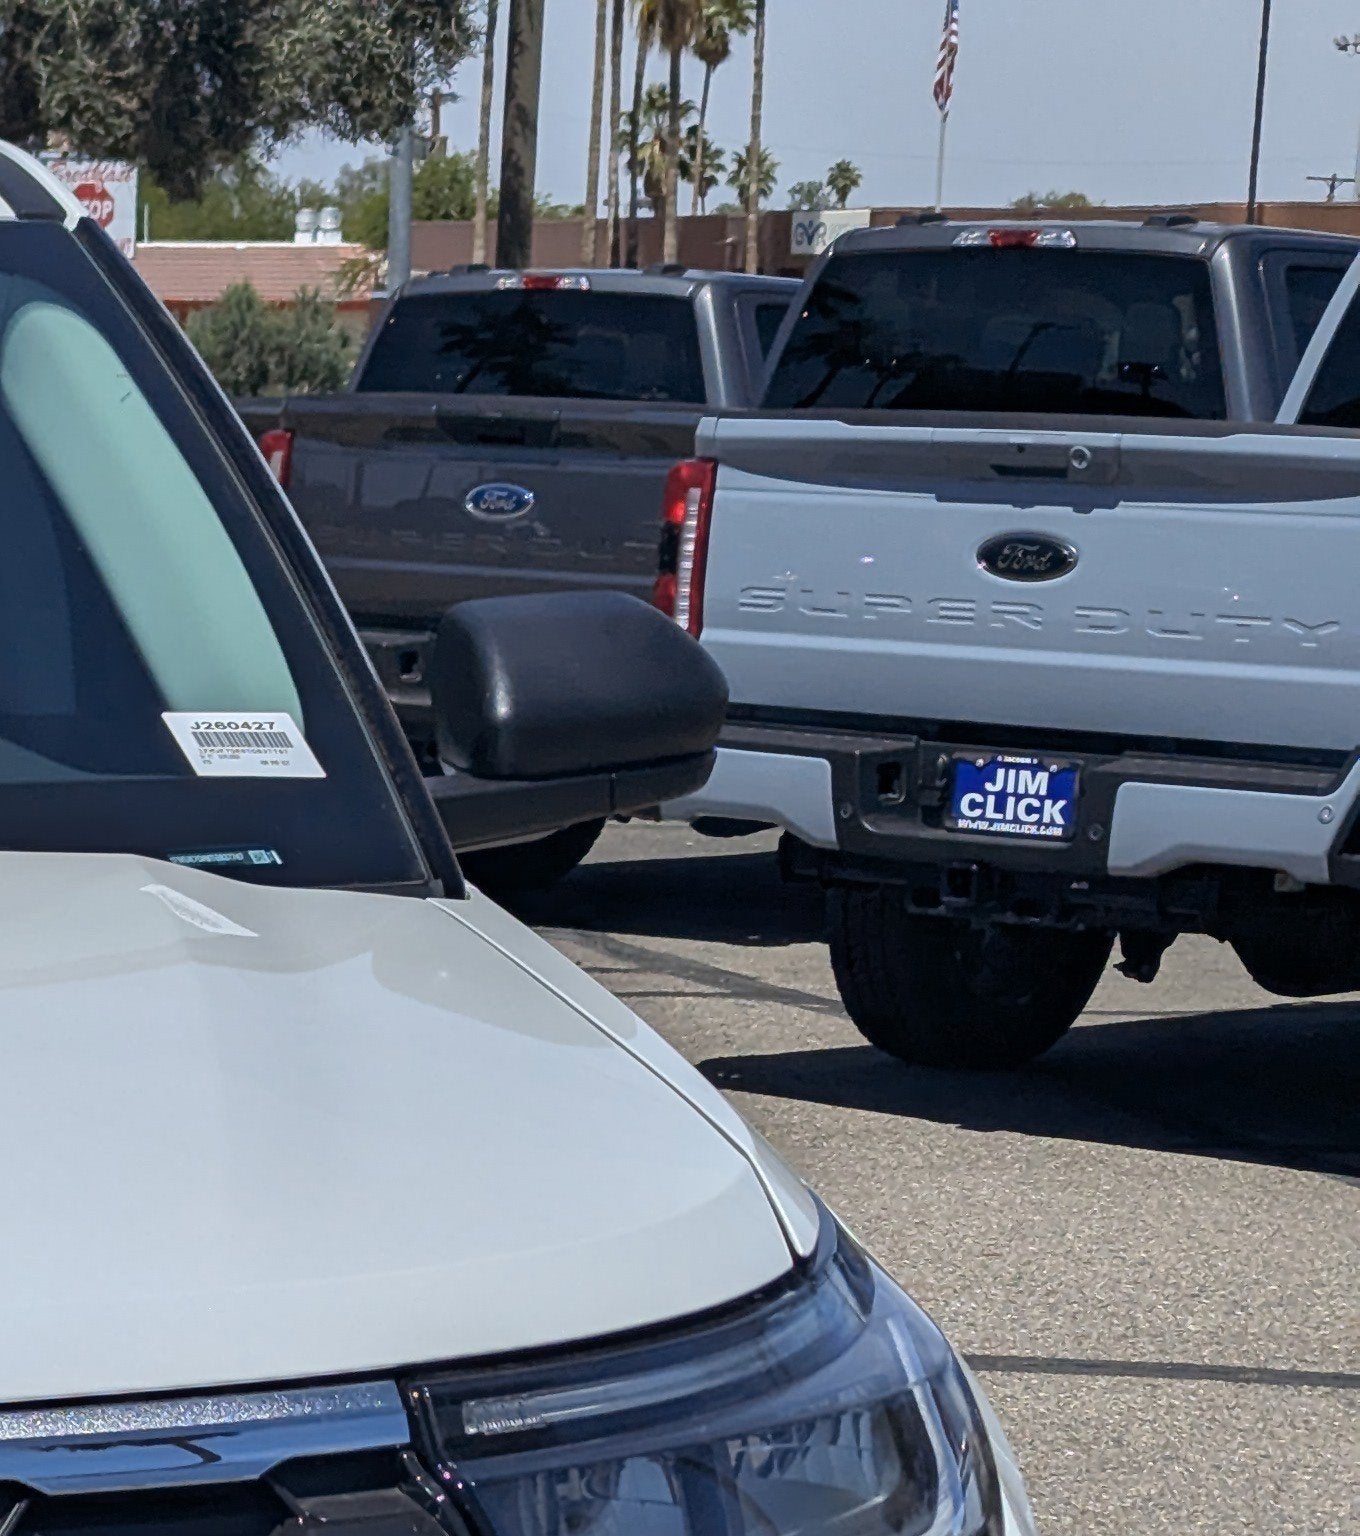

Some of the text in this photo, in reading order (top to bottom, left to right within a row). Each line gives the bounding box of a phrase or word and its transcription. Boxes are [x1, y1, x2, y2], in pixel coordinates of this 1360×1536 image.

[80, 199, 114, 220] OP
[997, 543, 1053, 571] Ford
[737, 586, 1341, 648] SUPER DUTY
[984, 767, 1050, 796] JIM
[960, 792, 1068, 825] CLICK
